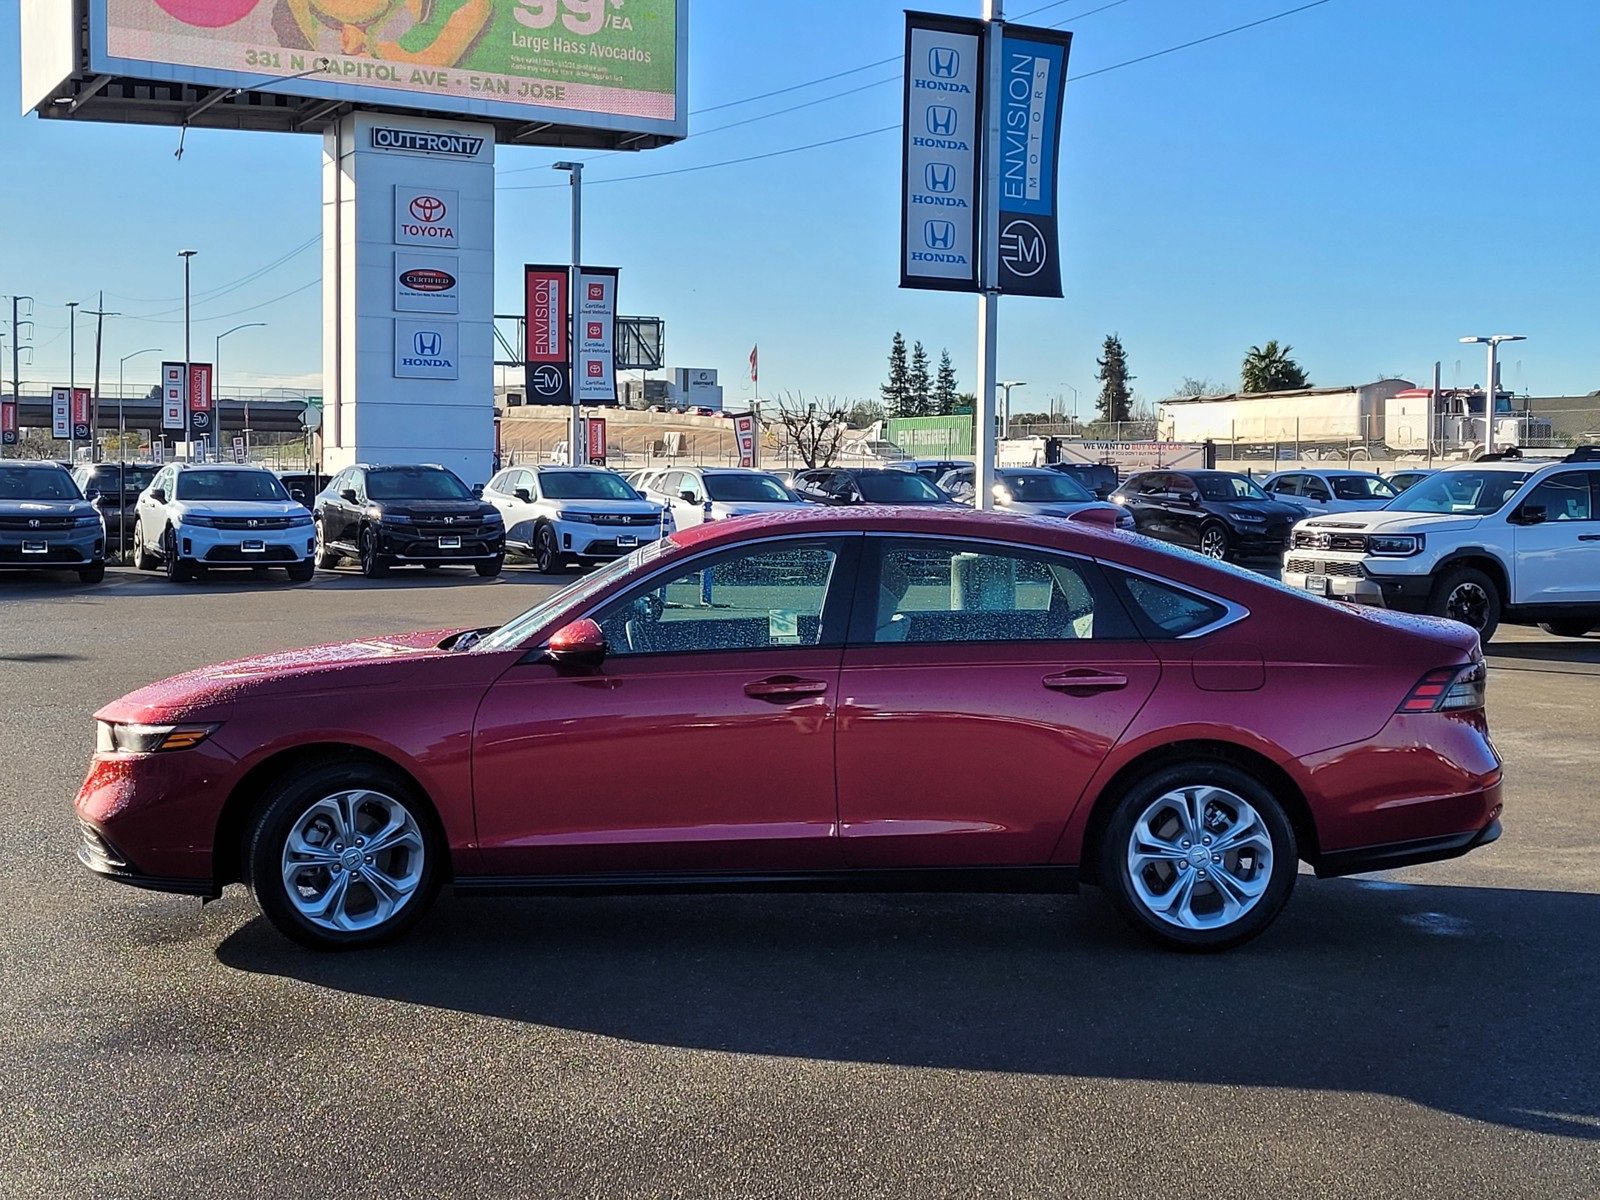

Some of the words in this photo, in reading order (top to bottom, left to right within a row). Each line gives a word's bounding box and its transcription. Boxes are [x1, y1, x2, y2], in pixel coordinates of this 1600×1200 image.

[512, 31, 550, 52] Large
[553, 37, 586, 55] Hass
[589, 42, 651, 63] Avocados
[245, 49, 282, 69] 331
[290, 54, 305, 70] N
[312, 57, 402, 83] CAPITOL
[409, 69, 448, 88] AVE
[469, 76, 510, 95] SAN
[517, 82, 566, 101] JOSE
[914, 79, 971, 94] HONDA
[1004, 53, 1033, 199] ENVISION
[1029, 70, 1046, 188] MOTORS
[912, 136, 969, 151] HONDA
[911, 194, 968, 208] HONDA
[401, 224, 455, 239] TOYOTA
[911, 251, 968, 265] HONDA
[406, 275, 450, 284] CERTIFIED
[535, 279, 548, 355] ENVISION
[402, 358, 452, 368] HONDA
[194, 370, 202, 407] ENVISION
